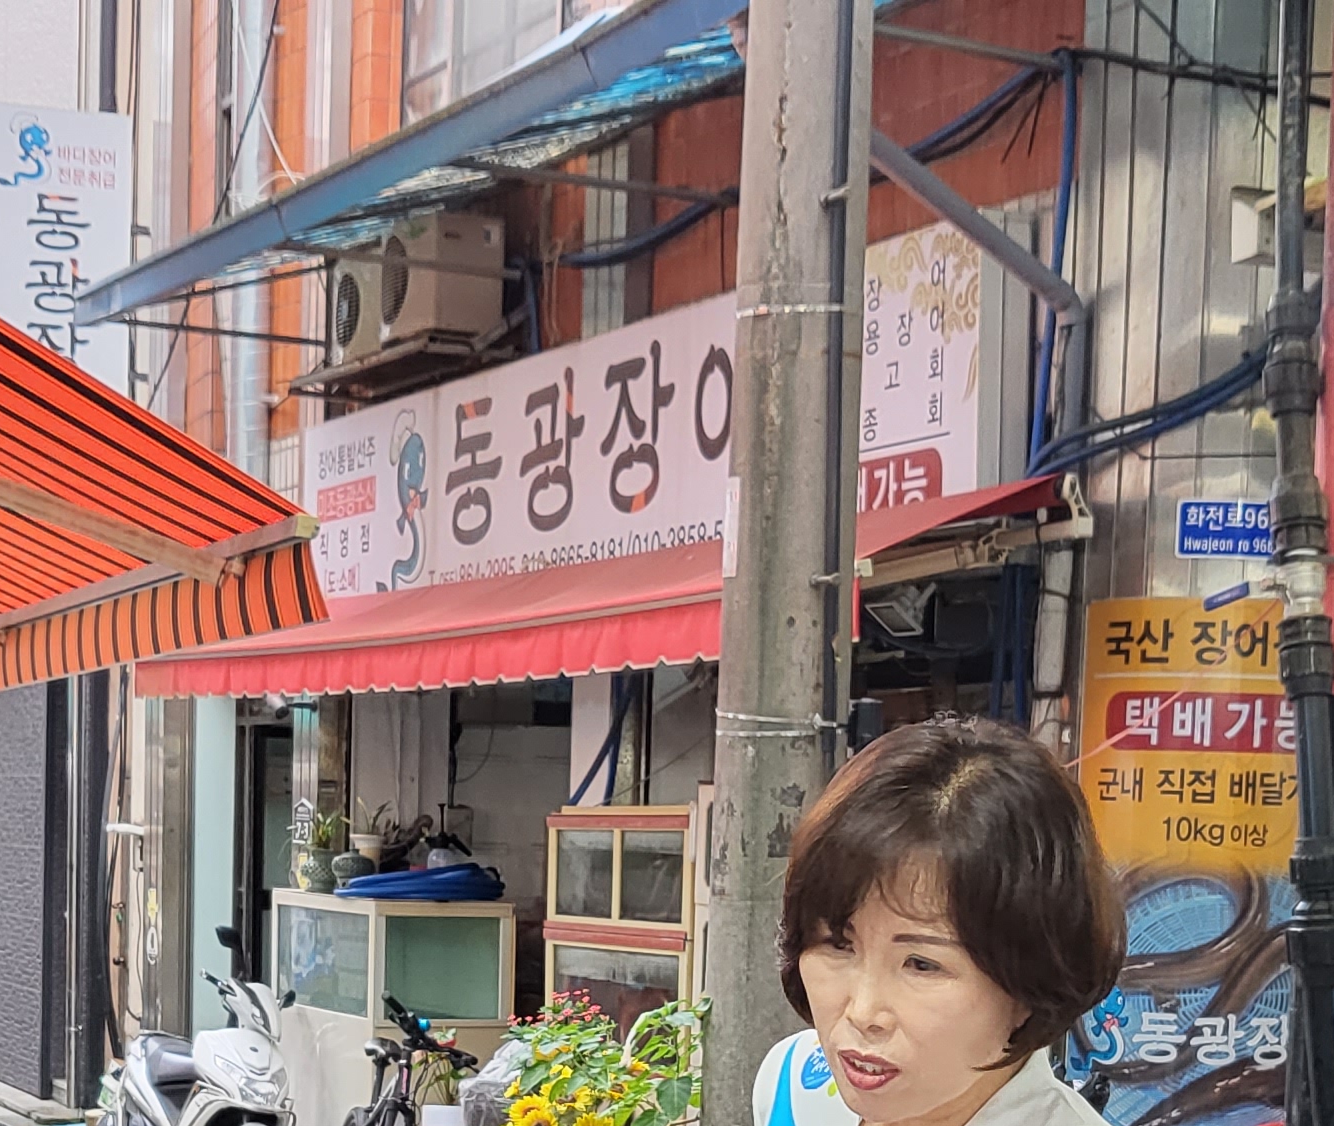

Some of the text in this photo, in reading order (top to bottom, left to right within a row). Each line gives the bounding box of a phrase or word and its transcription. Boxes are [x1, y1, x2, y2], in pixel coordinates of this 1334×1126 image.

[57, 146, 116, 167] 바다장어
[57, 167, 116, 190] 전문취급
[1184, 537, 1233, 554] Hwajeon
[1105, 618, 1280, 667] 국산 장어
[1097, 767, 1144, 803] 군내
[1156, 768, 1217, 805] 직접
[1162, 816, 1268, 847] 10kg 이상
